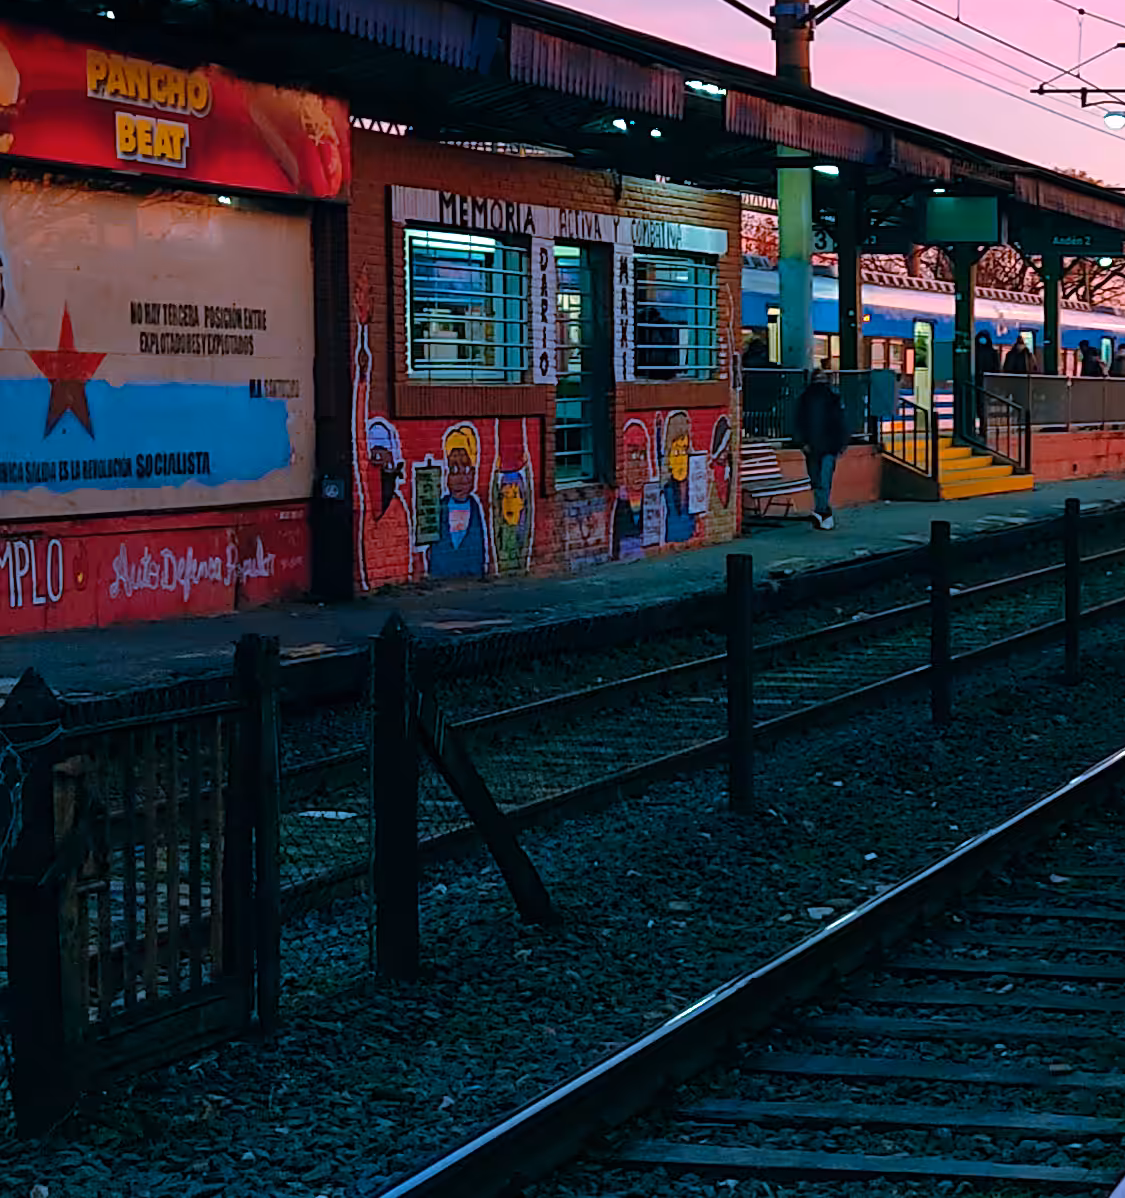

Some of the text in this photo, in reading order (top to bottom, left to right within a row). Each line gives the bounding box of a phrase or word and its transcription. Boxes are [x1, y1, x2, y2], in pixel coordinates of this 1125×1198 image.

[87, 50, 213, 118] PANCHO
[116, 112, 189, 168] BEAT
[439, 191, 535, 234] MEMORIA
[613, 217, 620, 242] Y
[814, 230, 826, 249] 3
[1085, 236, 1091, 245] 2
[130, 301, 143, 325] NO
[136, 451, 211, 478] SOCIALISTA
